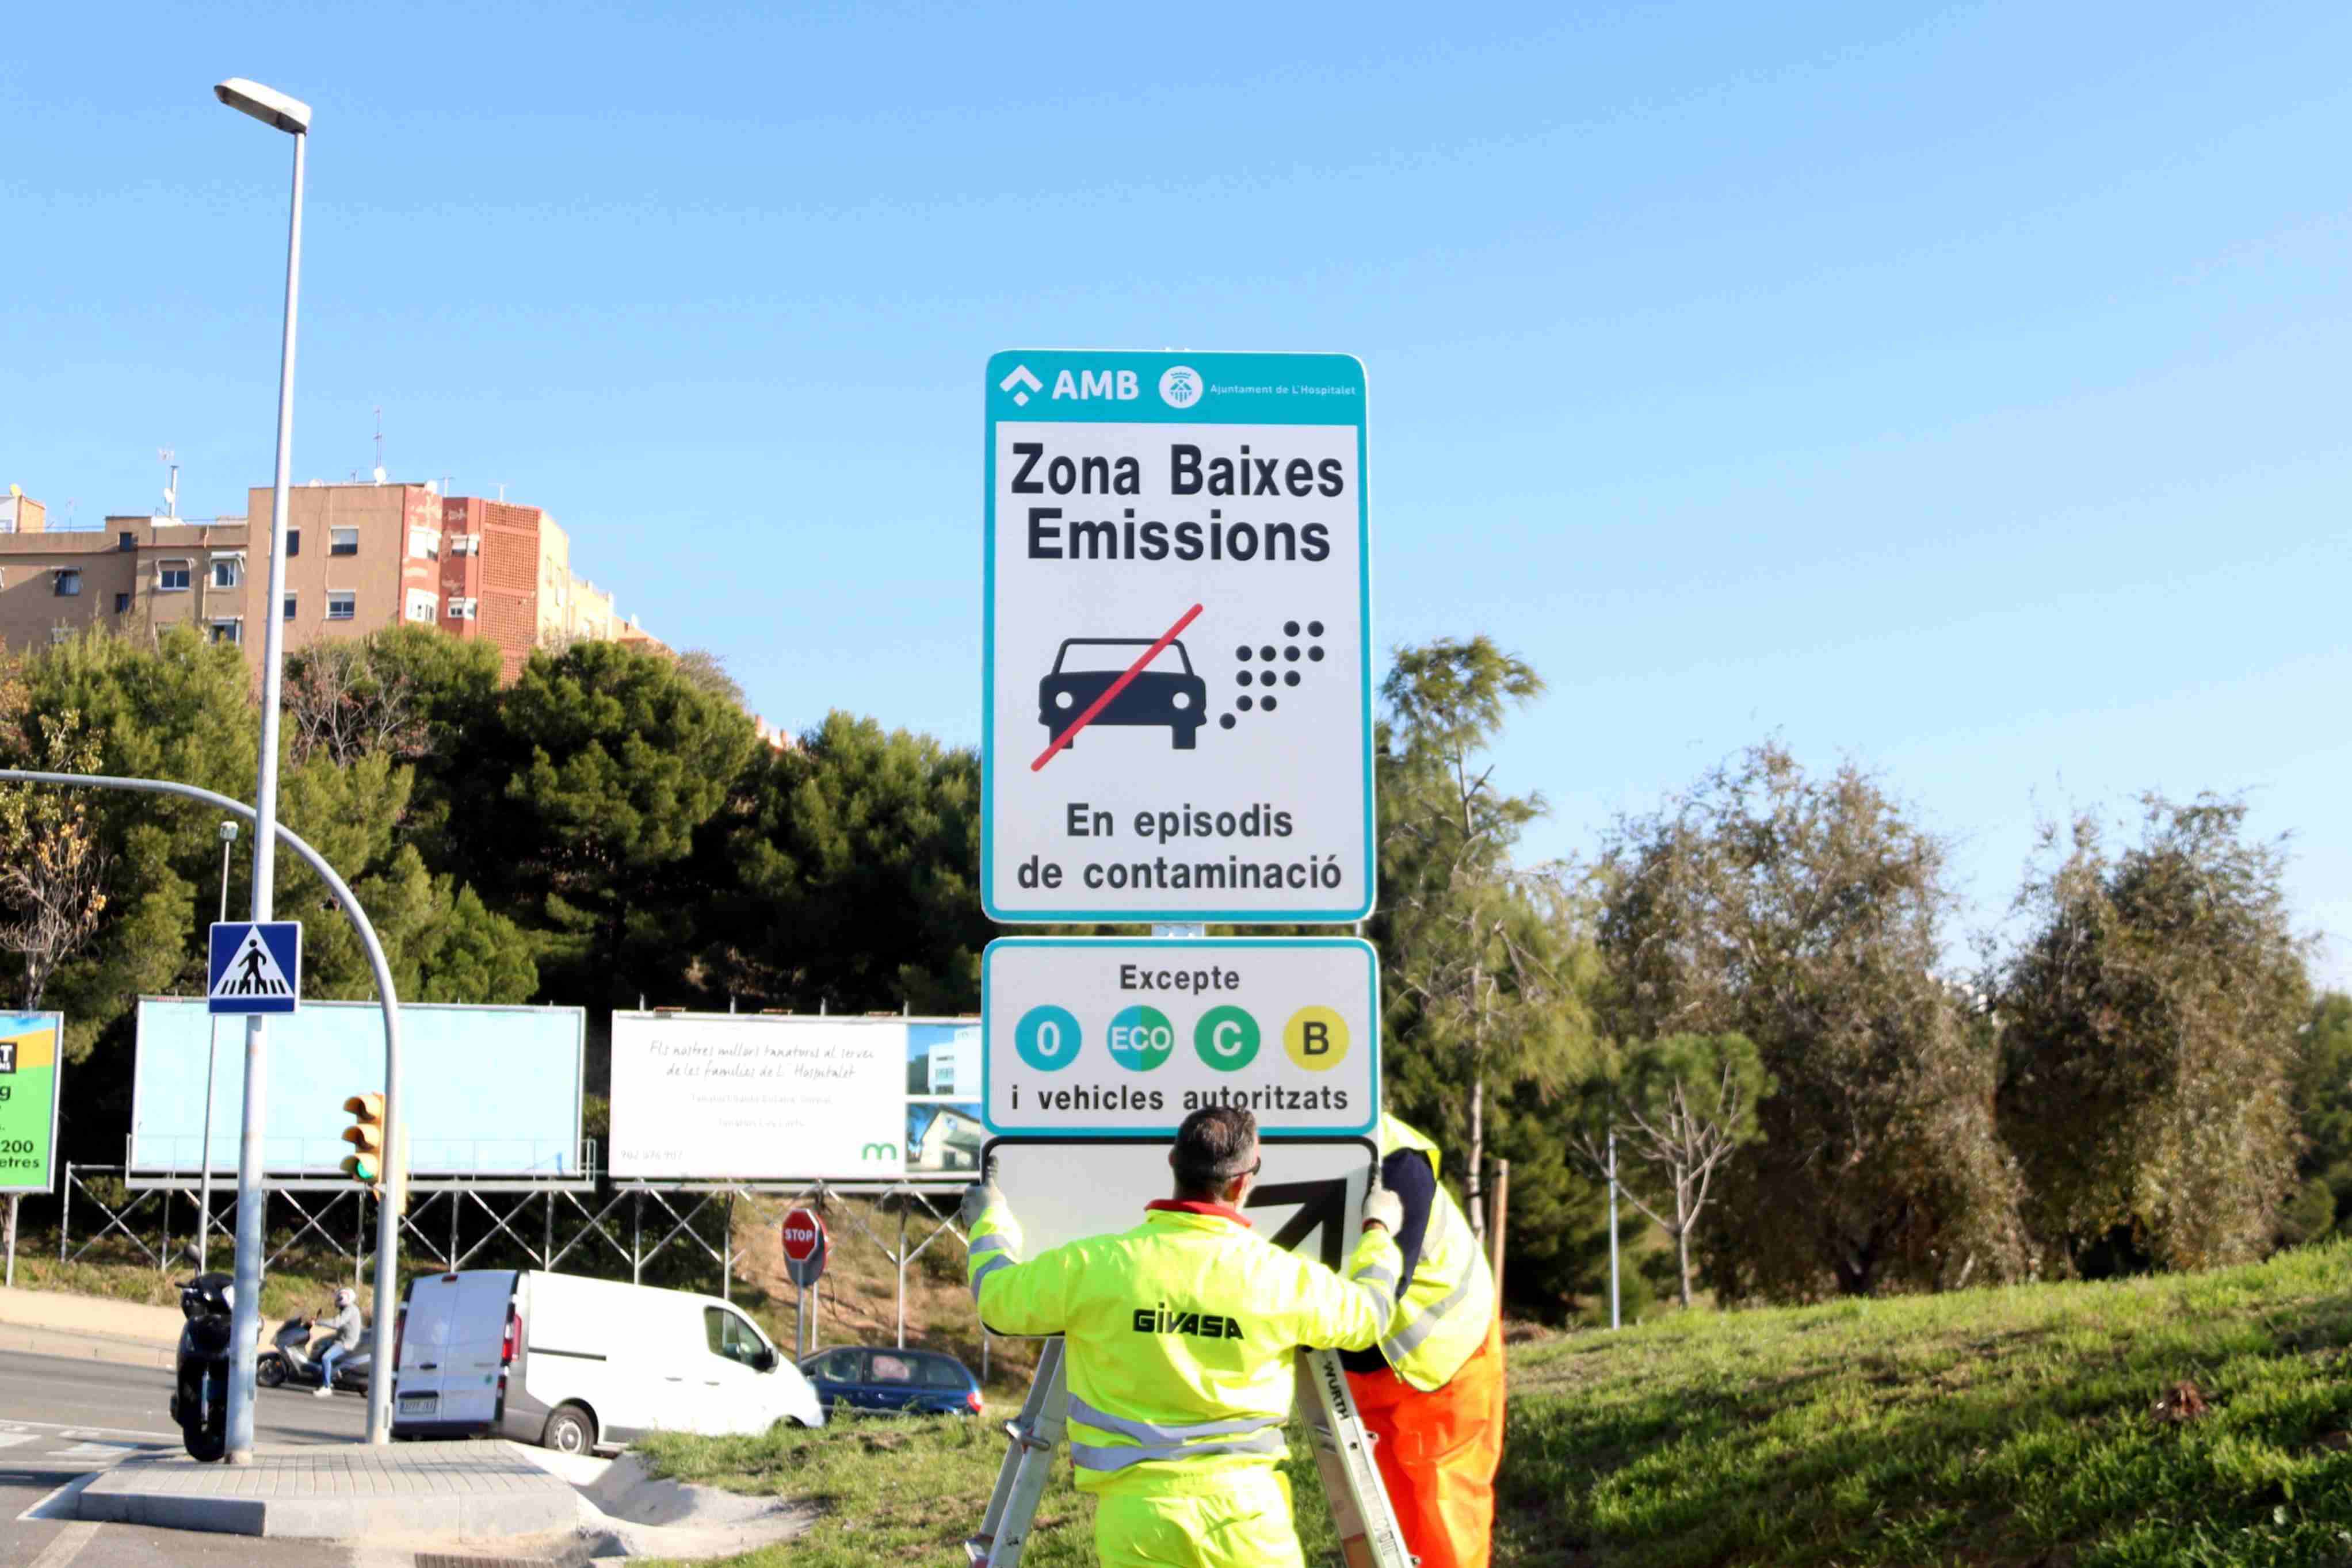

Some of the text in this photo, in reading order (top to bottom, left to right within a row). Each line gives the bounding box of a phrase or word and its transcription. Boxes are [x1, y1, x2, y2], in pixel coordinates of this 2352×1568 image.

[1052, 370, 1139, 400] AMB
[1210, 384, 1356, 396] Ajuntament de L'Hospitalet
[1011, 442, 1344, 498] Zona Baixes
[1028, 507, 1331, 562] Emissions
[1067, 803, 1293, 845] En episodis
[1017, 854, 1342, 890] de contaminació
[1120, 964, 1240, 996] Excepte
[1112, 1026, 1171, 1051] ECO
[1212, 1020, 1242, 1057] C
[1302, 1021, 1330, 1055] B
[1011, 1084, 1348, 1111] i vehicles autoritzats
[785, 1228, 813, 1241] STOP
